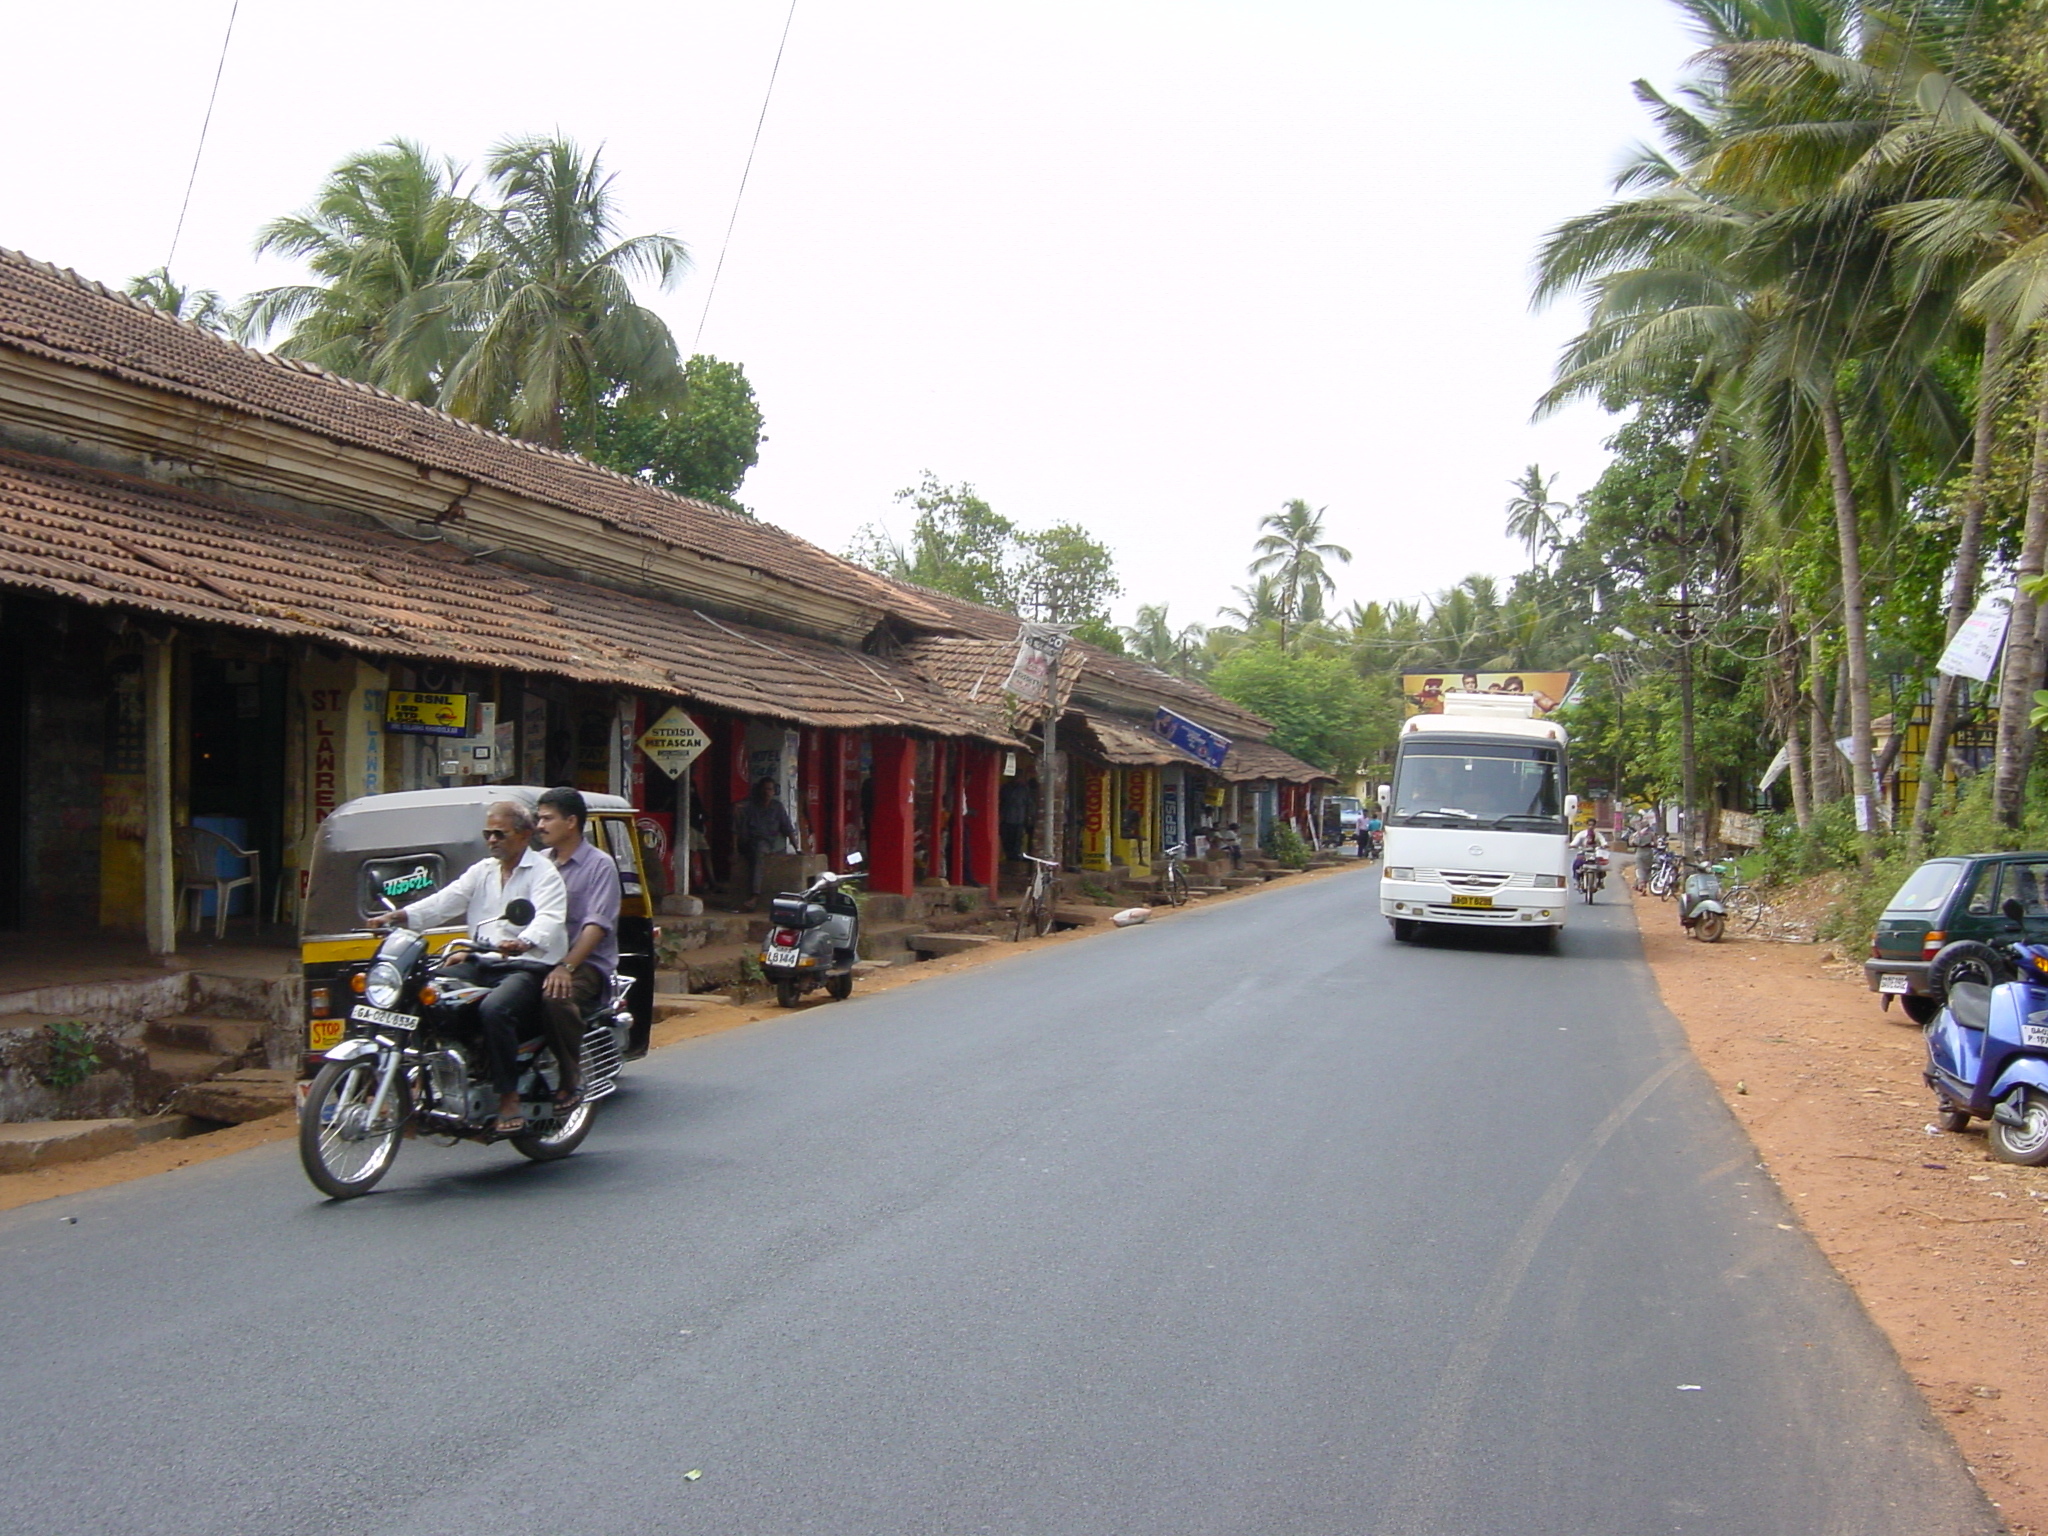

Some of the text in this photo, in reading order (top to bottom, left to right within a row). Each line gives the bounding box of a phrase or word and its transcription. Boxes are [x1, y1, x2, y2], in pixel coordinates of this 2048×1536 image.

[414, 694, 453, 705] BSNL
[646, 739, 701, 748] METASCAN
[365, 720, 378, 797] LAWR
[1165, 800, 1177, 845] PEPSI
[313, 1022, 340, 1043] STOP
